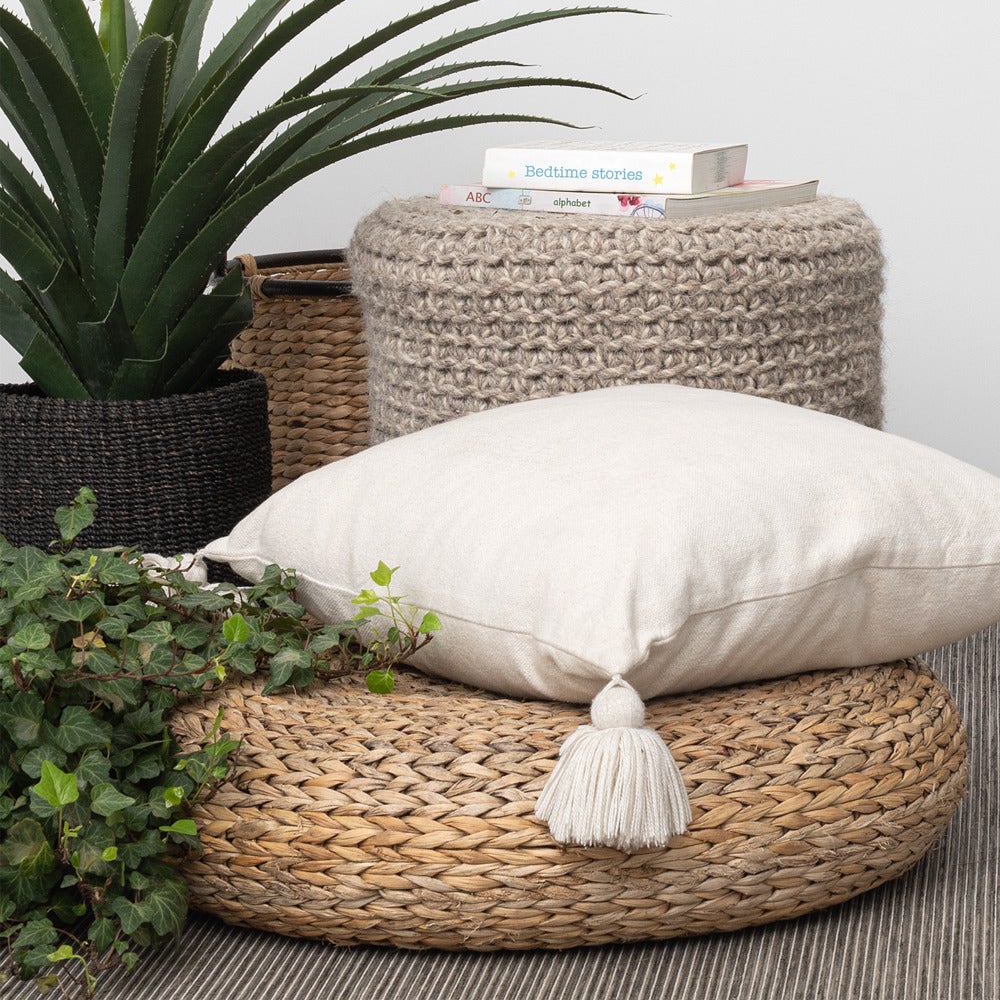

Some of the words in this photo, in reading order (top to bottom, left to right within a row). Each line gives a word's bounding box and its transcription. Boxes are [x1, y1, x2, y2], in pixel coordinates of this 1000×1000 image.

[524, 165, 588, 179] Bedtime
[591, 167, 643, 181] stories
[465, 191, 491, 204] ABC
[553, 198, 591, 208] alphabet
